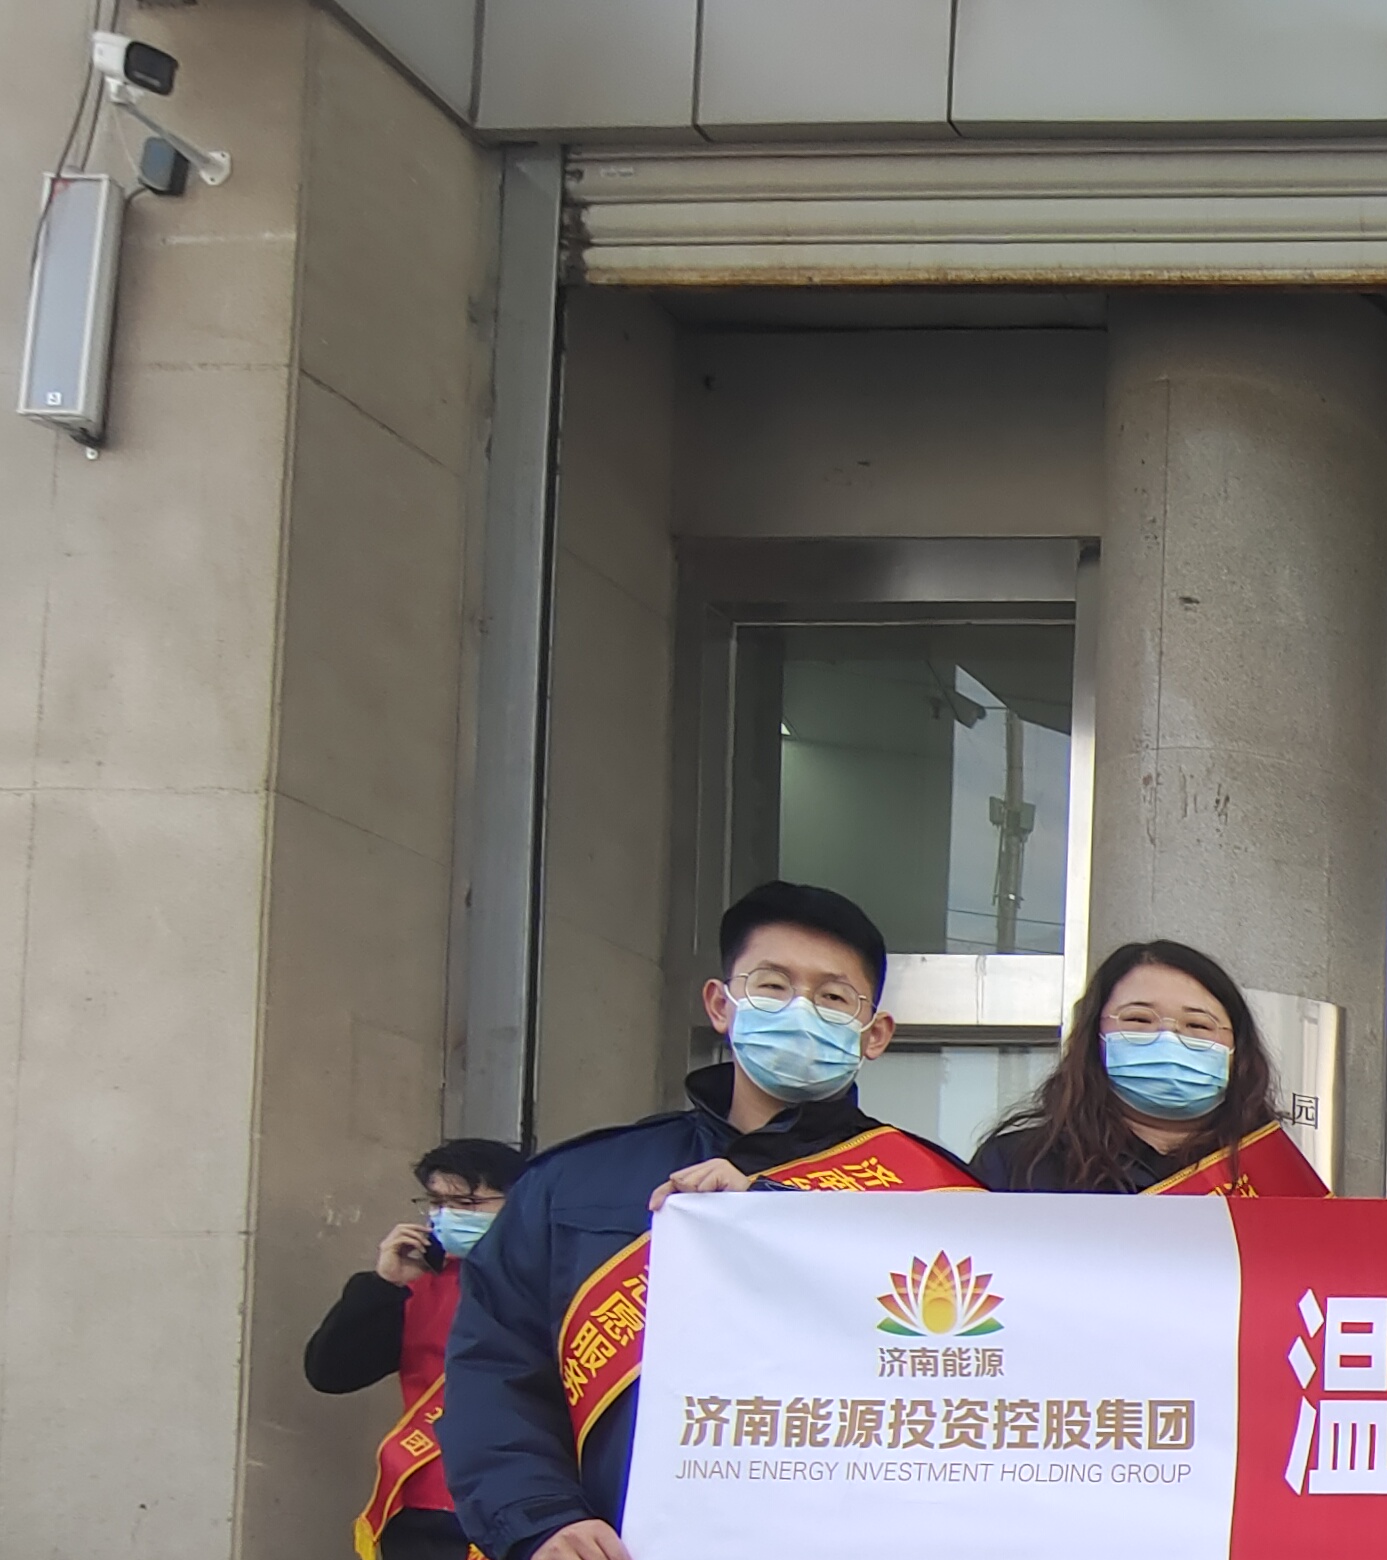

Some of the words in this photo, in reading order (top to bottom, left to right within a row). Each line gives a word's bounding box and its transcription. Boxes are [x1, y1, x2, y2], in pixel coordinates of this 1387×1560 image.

[878, 1348, 1005, 1379] 济南能源
[680, 1395, 1196, 1451] 济南能源投资控股集团
[675, 1459, 741, 1481] JINAN
[748, 1461, 839, 1482] ENERGY
[846, 1462, 994, 1484] INVESTMENT
[1000, 1463, 1103, 1484] HOLDING
[1110, 1463, 1192, 1484] GROUP
